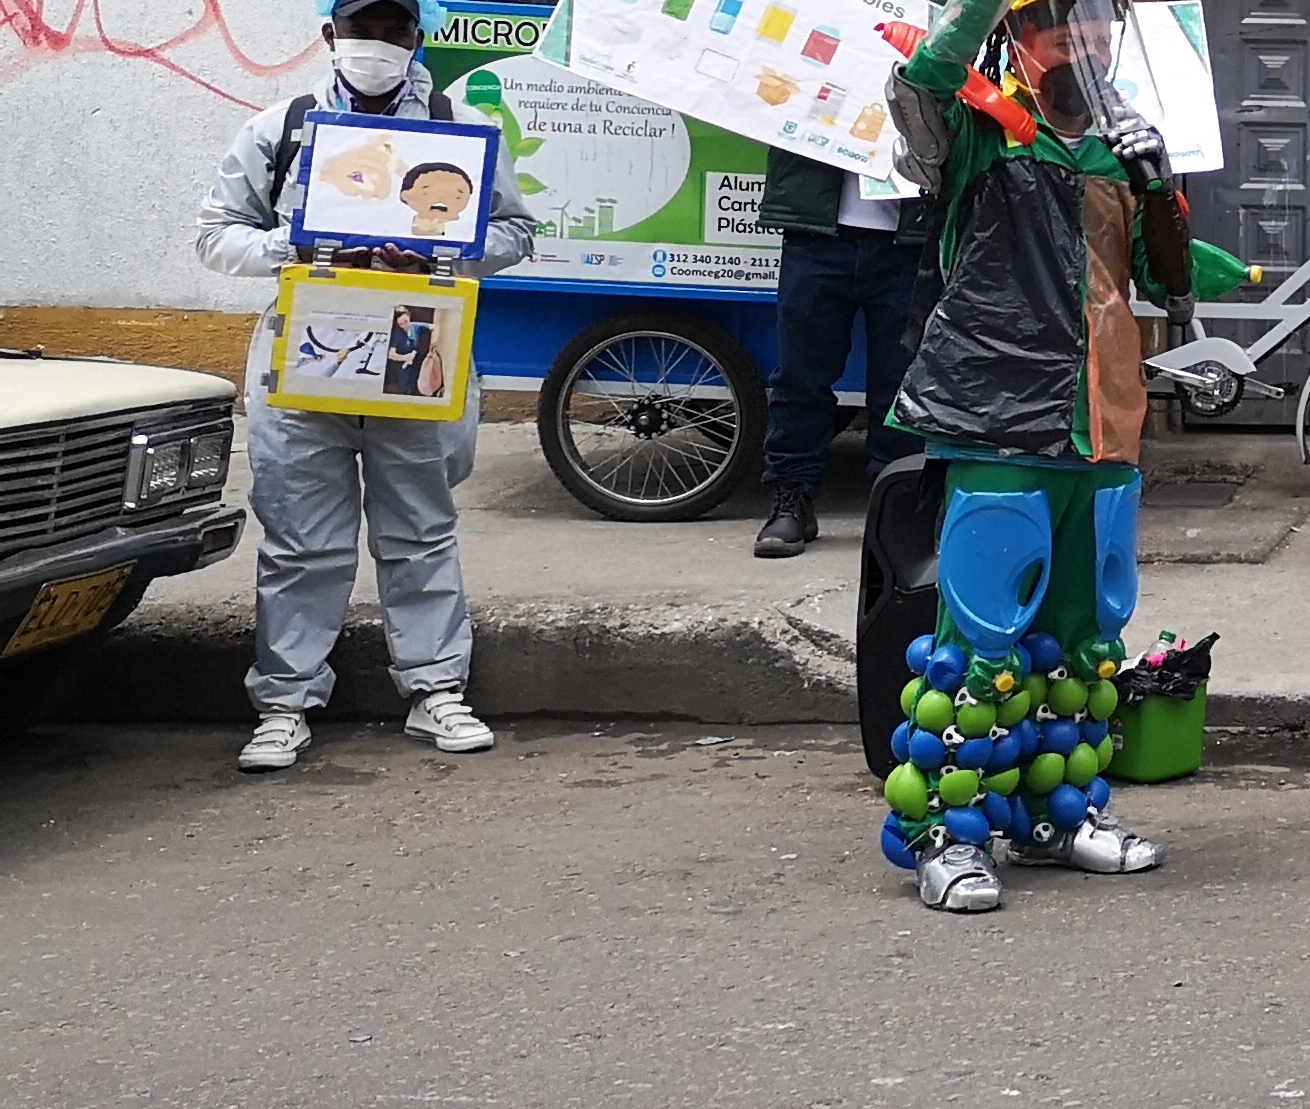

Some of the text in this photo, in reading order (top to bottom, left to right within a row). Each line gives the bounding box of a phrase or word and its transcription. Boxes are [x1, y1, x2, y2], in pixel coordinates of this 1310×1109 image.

[433, 18, 548, 46] MICRO
[504, 78, 522, 90] Un
[526, 79, 564, 93] medio
[518, 97, 672, 116] requiere de tu Conciencia
[527, 114, 676, 138] de una a Reciclar !
[669, 253, 688, 263] 312
[692, 254, 711, 264] 340
[714, 255, 741, 266] 2140
[751, 257, 770, 268] 211
